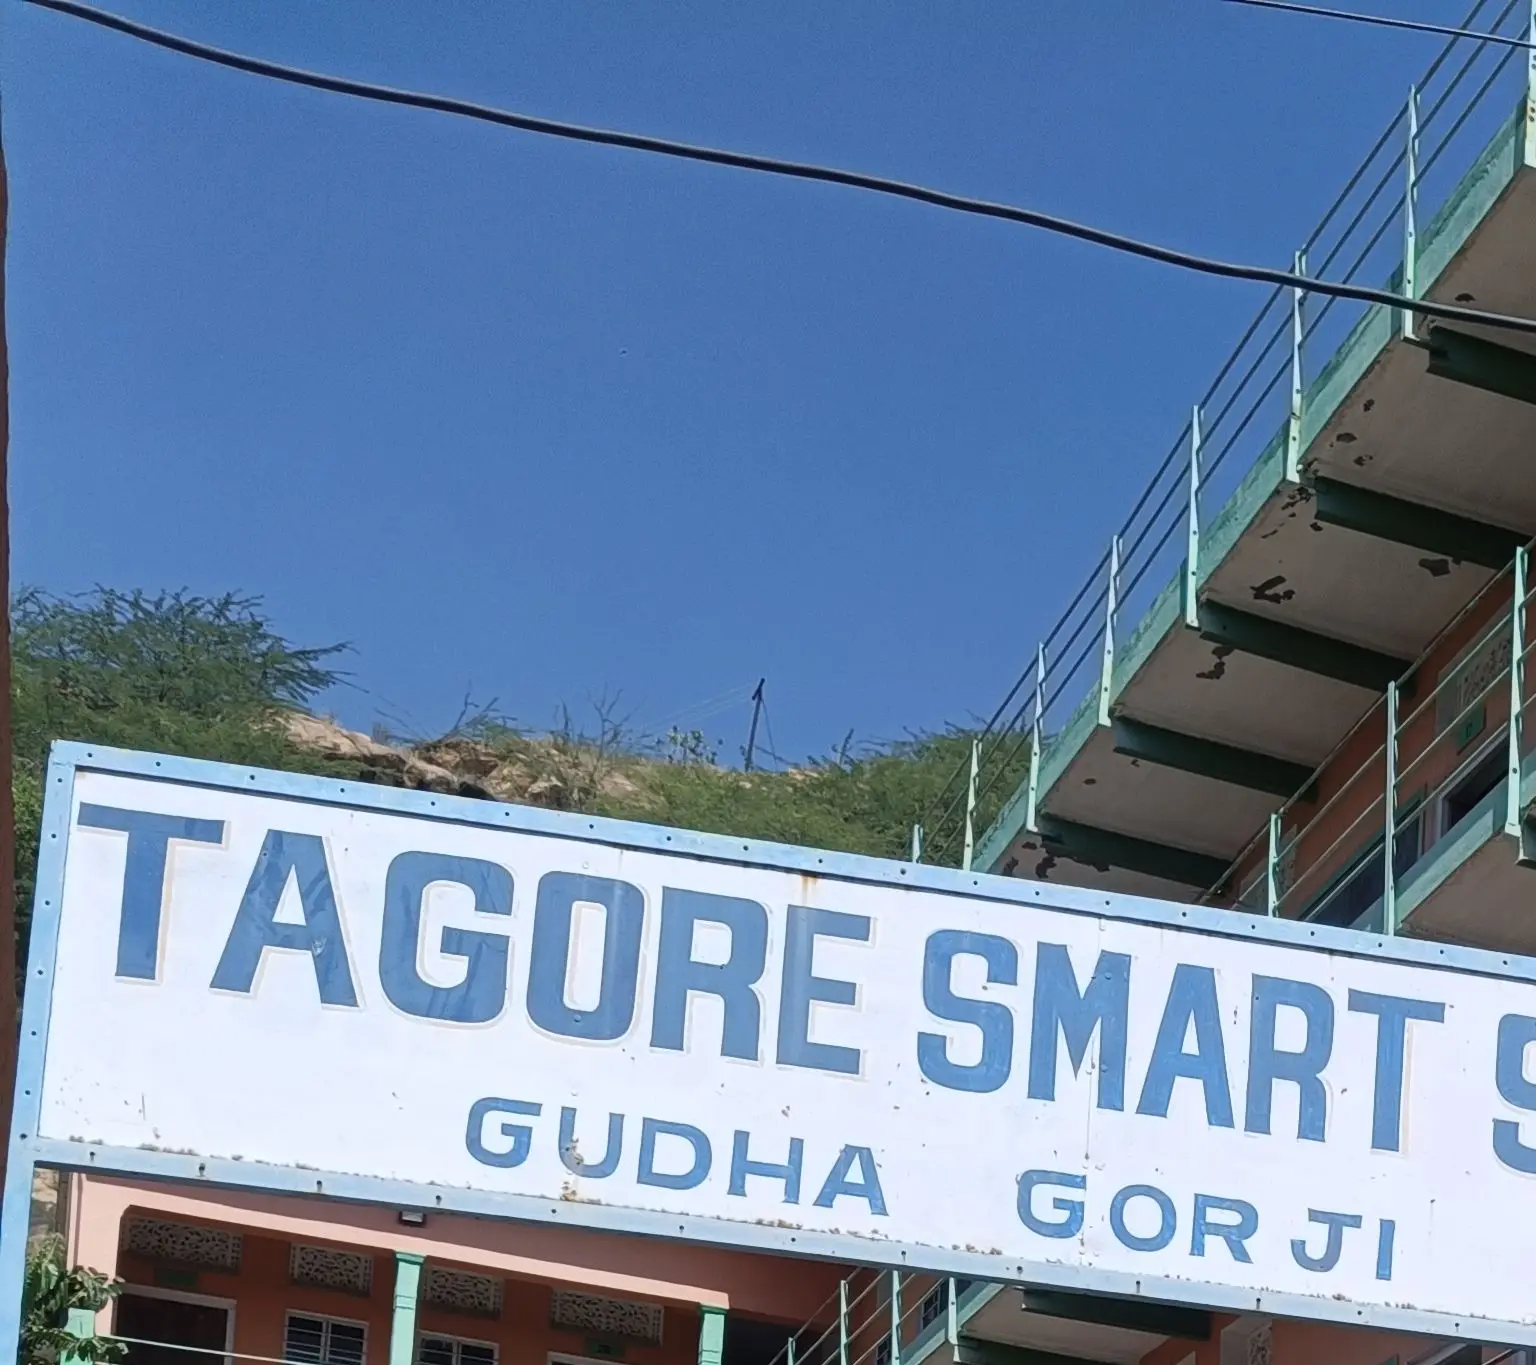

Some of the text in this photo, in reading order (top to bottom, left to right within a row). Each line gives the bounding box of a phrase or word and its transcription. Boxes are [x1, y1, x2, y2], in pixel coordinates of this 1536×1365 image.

[77, 802, 872, 1076] TAGORE
[916, 929, 1446, 1153] SMART
[465, 1096, 888, 1217] GUDHA
